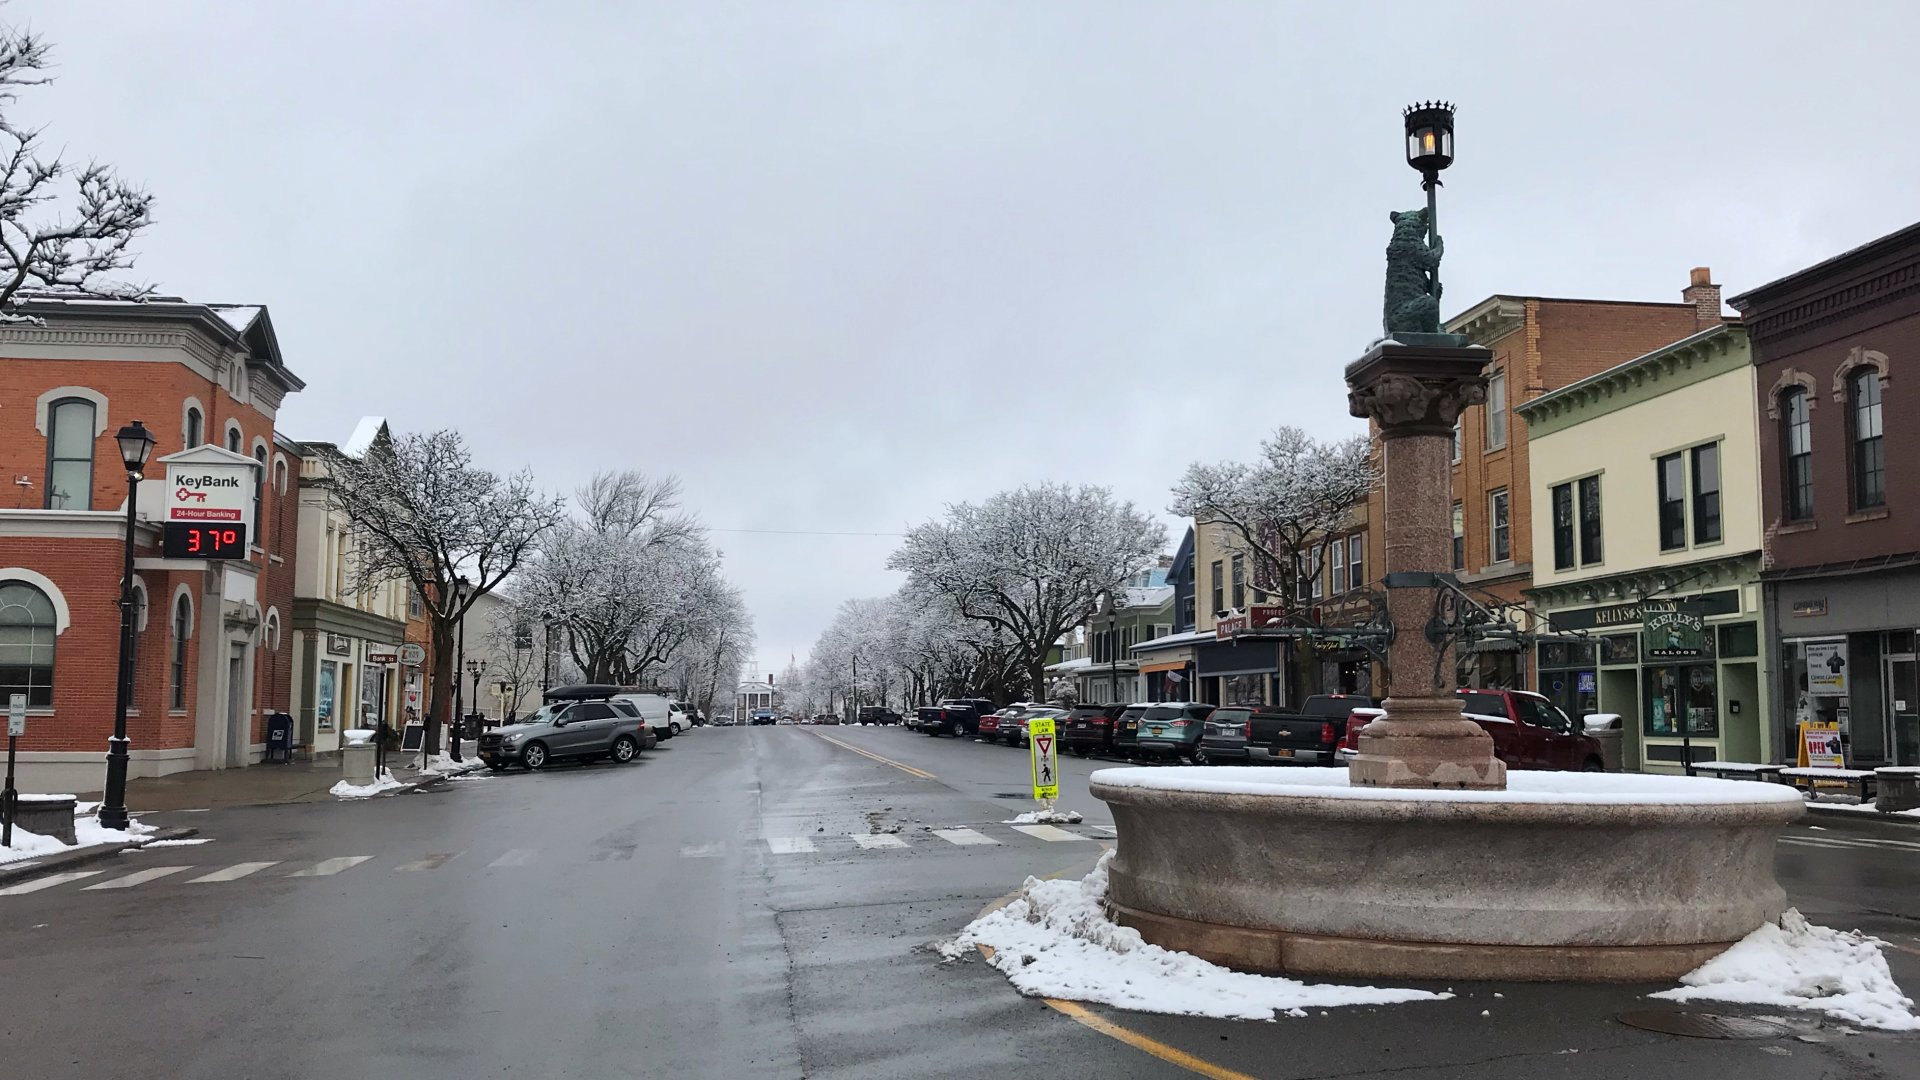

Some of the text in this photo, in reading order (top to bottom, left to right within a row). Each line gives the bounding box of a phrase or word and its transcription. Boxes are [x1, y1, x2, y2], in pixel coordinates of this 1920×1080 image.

[176, 475, 239, 489] KeyBank
[206, 511, 236, 519] Banking
[1596, 608, 1629, 624] KELLY'S
[1648, 613, 1702, 632] KELLY'S
[1809, 741, 1826, 754] OPEN
